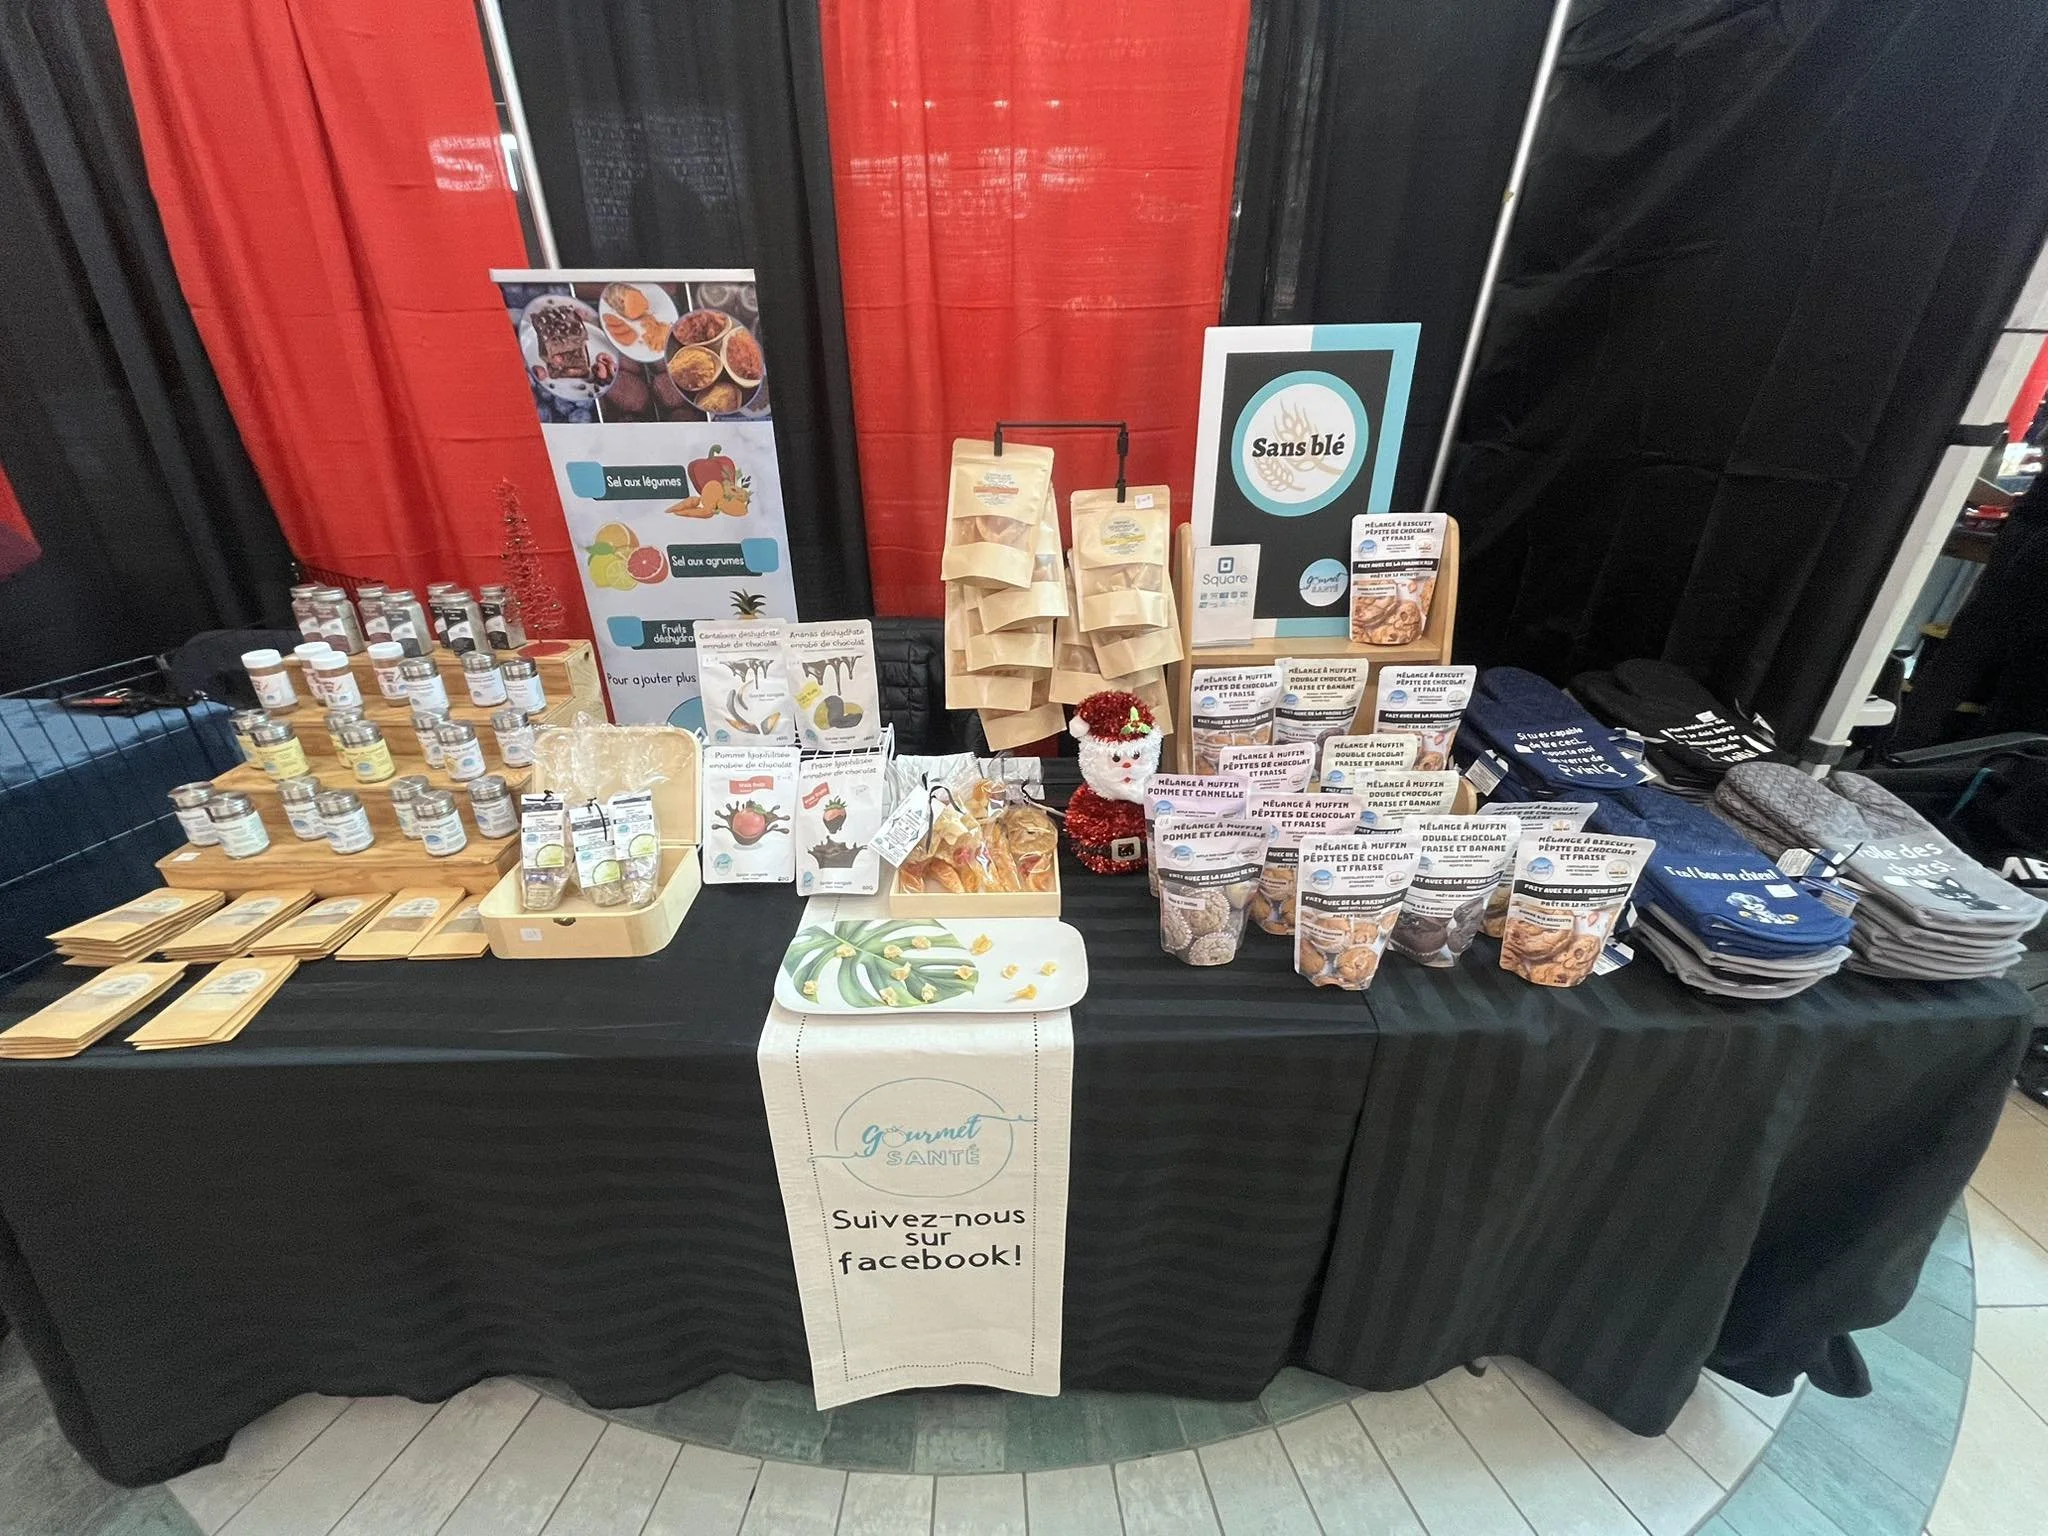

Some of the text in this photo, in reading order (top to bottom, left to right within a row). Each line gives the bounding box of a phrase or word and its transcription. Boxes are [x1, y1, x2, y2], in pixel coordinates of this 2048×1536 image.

[1251, 433, 1345, 458] Sans blé
[607, 475, 682, 490] Sel aux légumes
[672, 555, 744, 569] Sel aux agrumes
[1202, 573, 1248, 587] Square
[661, 623, 687, 634] Fruits
[653, 633, 695, 645] déshydra
[607, 672, 628, 686] Pour
[676, 673, 697, 687] plus
[1194, 683, 1228, 691] PÉPITES
[1517, 732, 1527, 740] Si
[1550, 726, 1584, 737] capable
[1334, 741, 1369, 749] MÉLANGE
[1223, 762, 1259, 770] PÉPITES
[1273, 759, 1310, 767] CHOCOLAT
[1158, 778, 1197, 787] MÉLANGE
[1366, 780, 1404, 788] MÉLANGE
[1148, 788, 1180, 796] POMME
[1195, 790, 1244, 798] CANNELLE
[1263, 800, 1304, 808] MÉLANGE
[1252, 809, 1293, 818] PÉPITES
[1173, 823, 1215, 831] MÉLANGE
[1227, 823, 1263, 831] MUFFIN
[1419, 822, 1461, 831] MÉLANGE
[1162, 831, 1267, 842] POMME ET CANNELLE
[1538, 836, 1583, 844] MÉLANGE
[1592, 839, 1635, 848] BISCUIT
[1315, 842, 1360, 851] MÉLANGE
[1371, 842, 1407, 850] MUFFIN
[1421, 845, 1454, 853] FRAISE
[1539, 844, 1571, 852] PÉPITE
[1587, 847, 1637, 856] CHOCOLAT
[1900, 843, 1943, 859] des
[1303, 852, 1349, 863] PÉPITES
[1352, 854, 1365, 862] DE
[1367, 852, 1415, 861] CHOCOLAT
[1349, 864, 1384, 872] FRAISE
[1524, 883, 1543, 892] FAIT
[886, 1144, 980, 1166] SANTÉ
[832, 1209, 1026, 1229] Suivez-nous
[905, 1232, 951, 1246] sur
[838, 1244, 1022, 1275] facebook!
